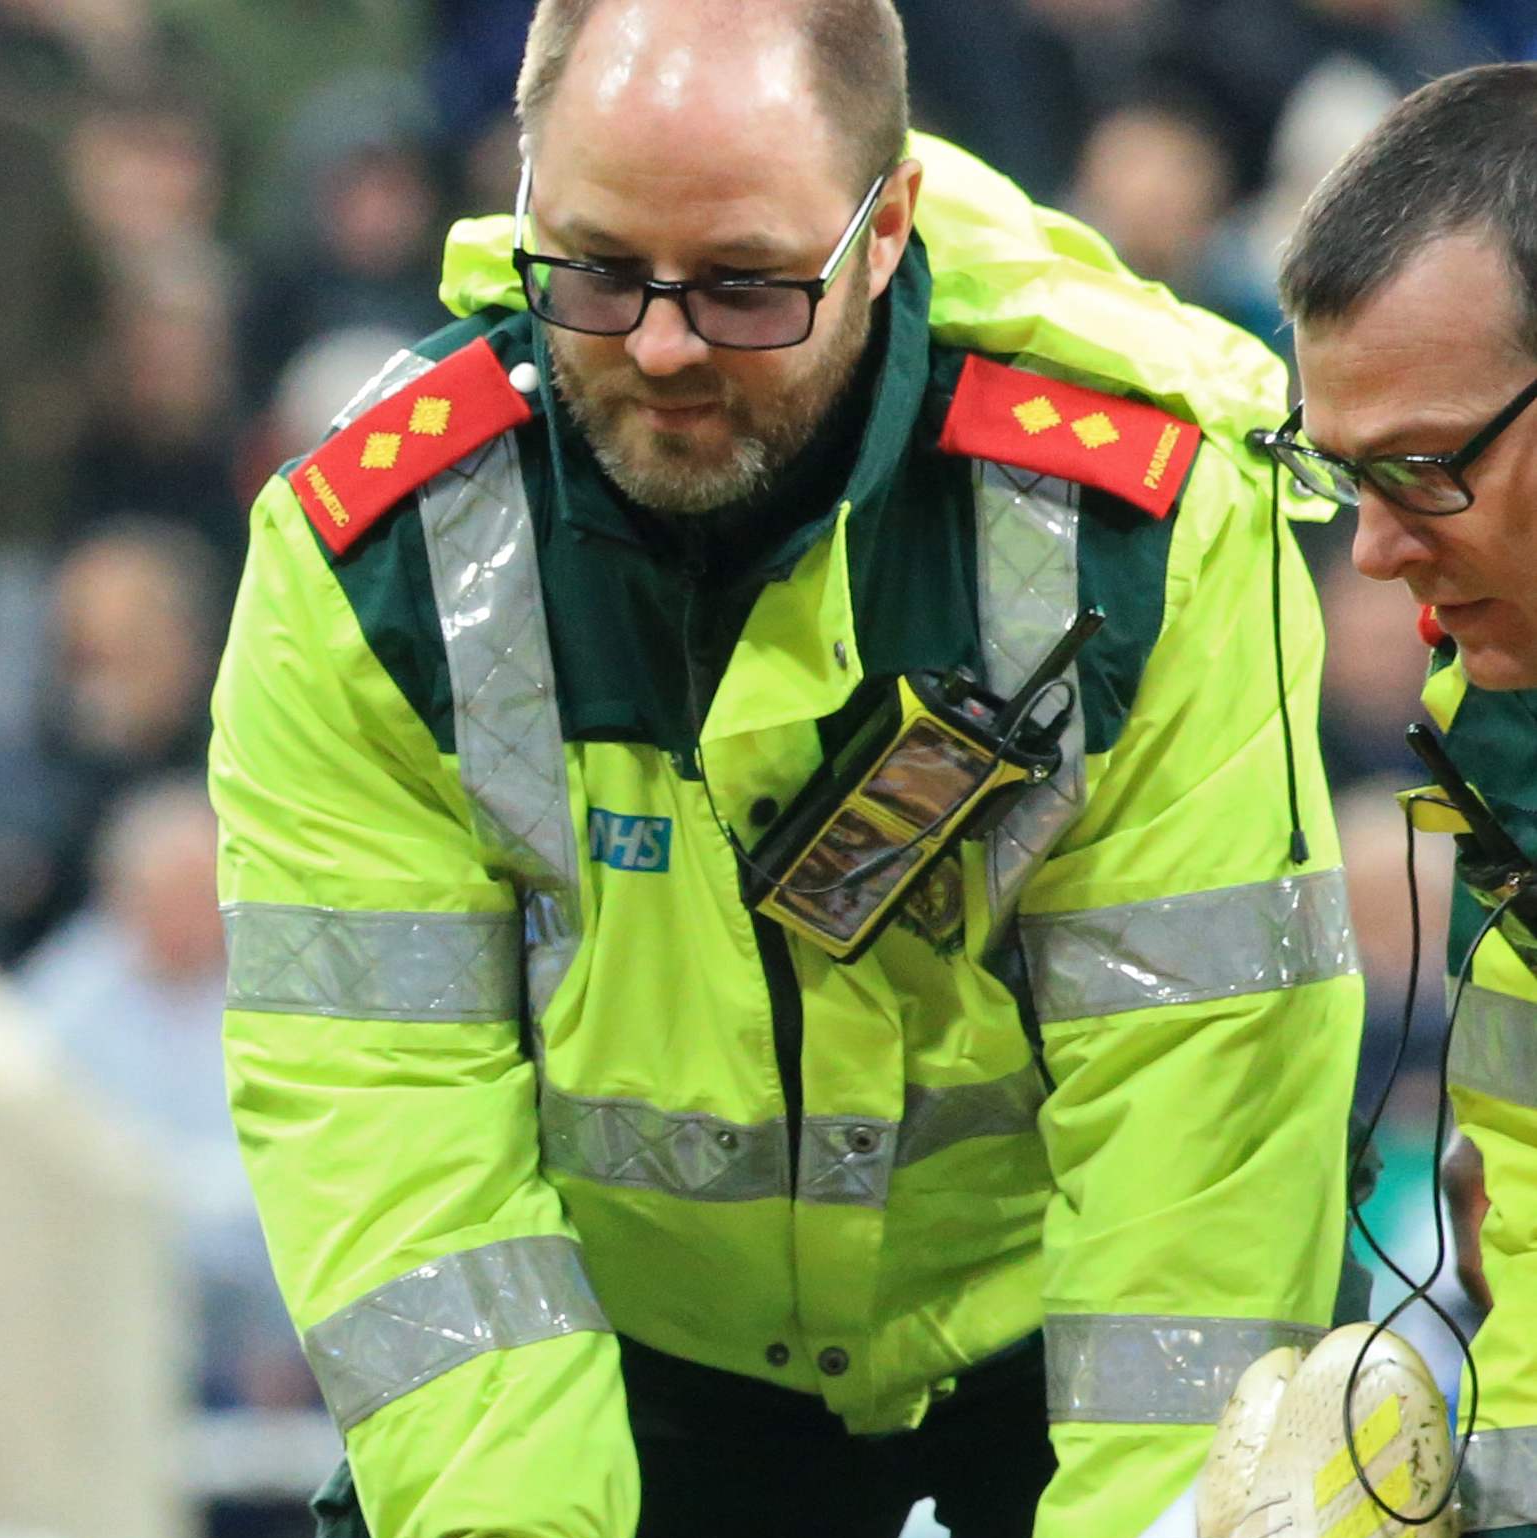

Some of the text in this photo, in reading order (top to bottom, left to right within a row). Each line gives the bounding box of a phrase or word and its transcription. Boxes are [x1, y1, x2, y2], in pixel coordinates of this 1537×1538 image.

[1143, 423, 1181, 490] PARAMEDIC
[305, 464, 350, 528] PARAMEDIC
[589, 812, 664, 868] NHS
